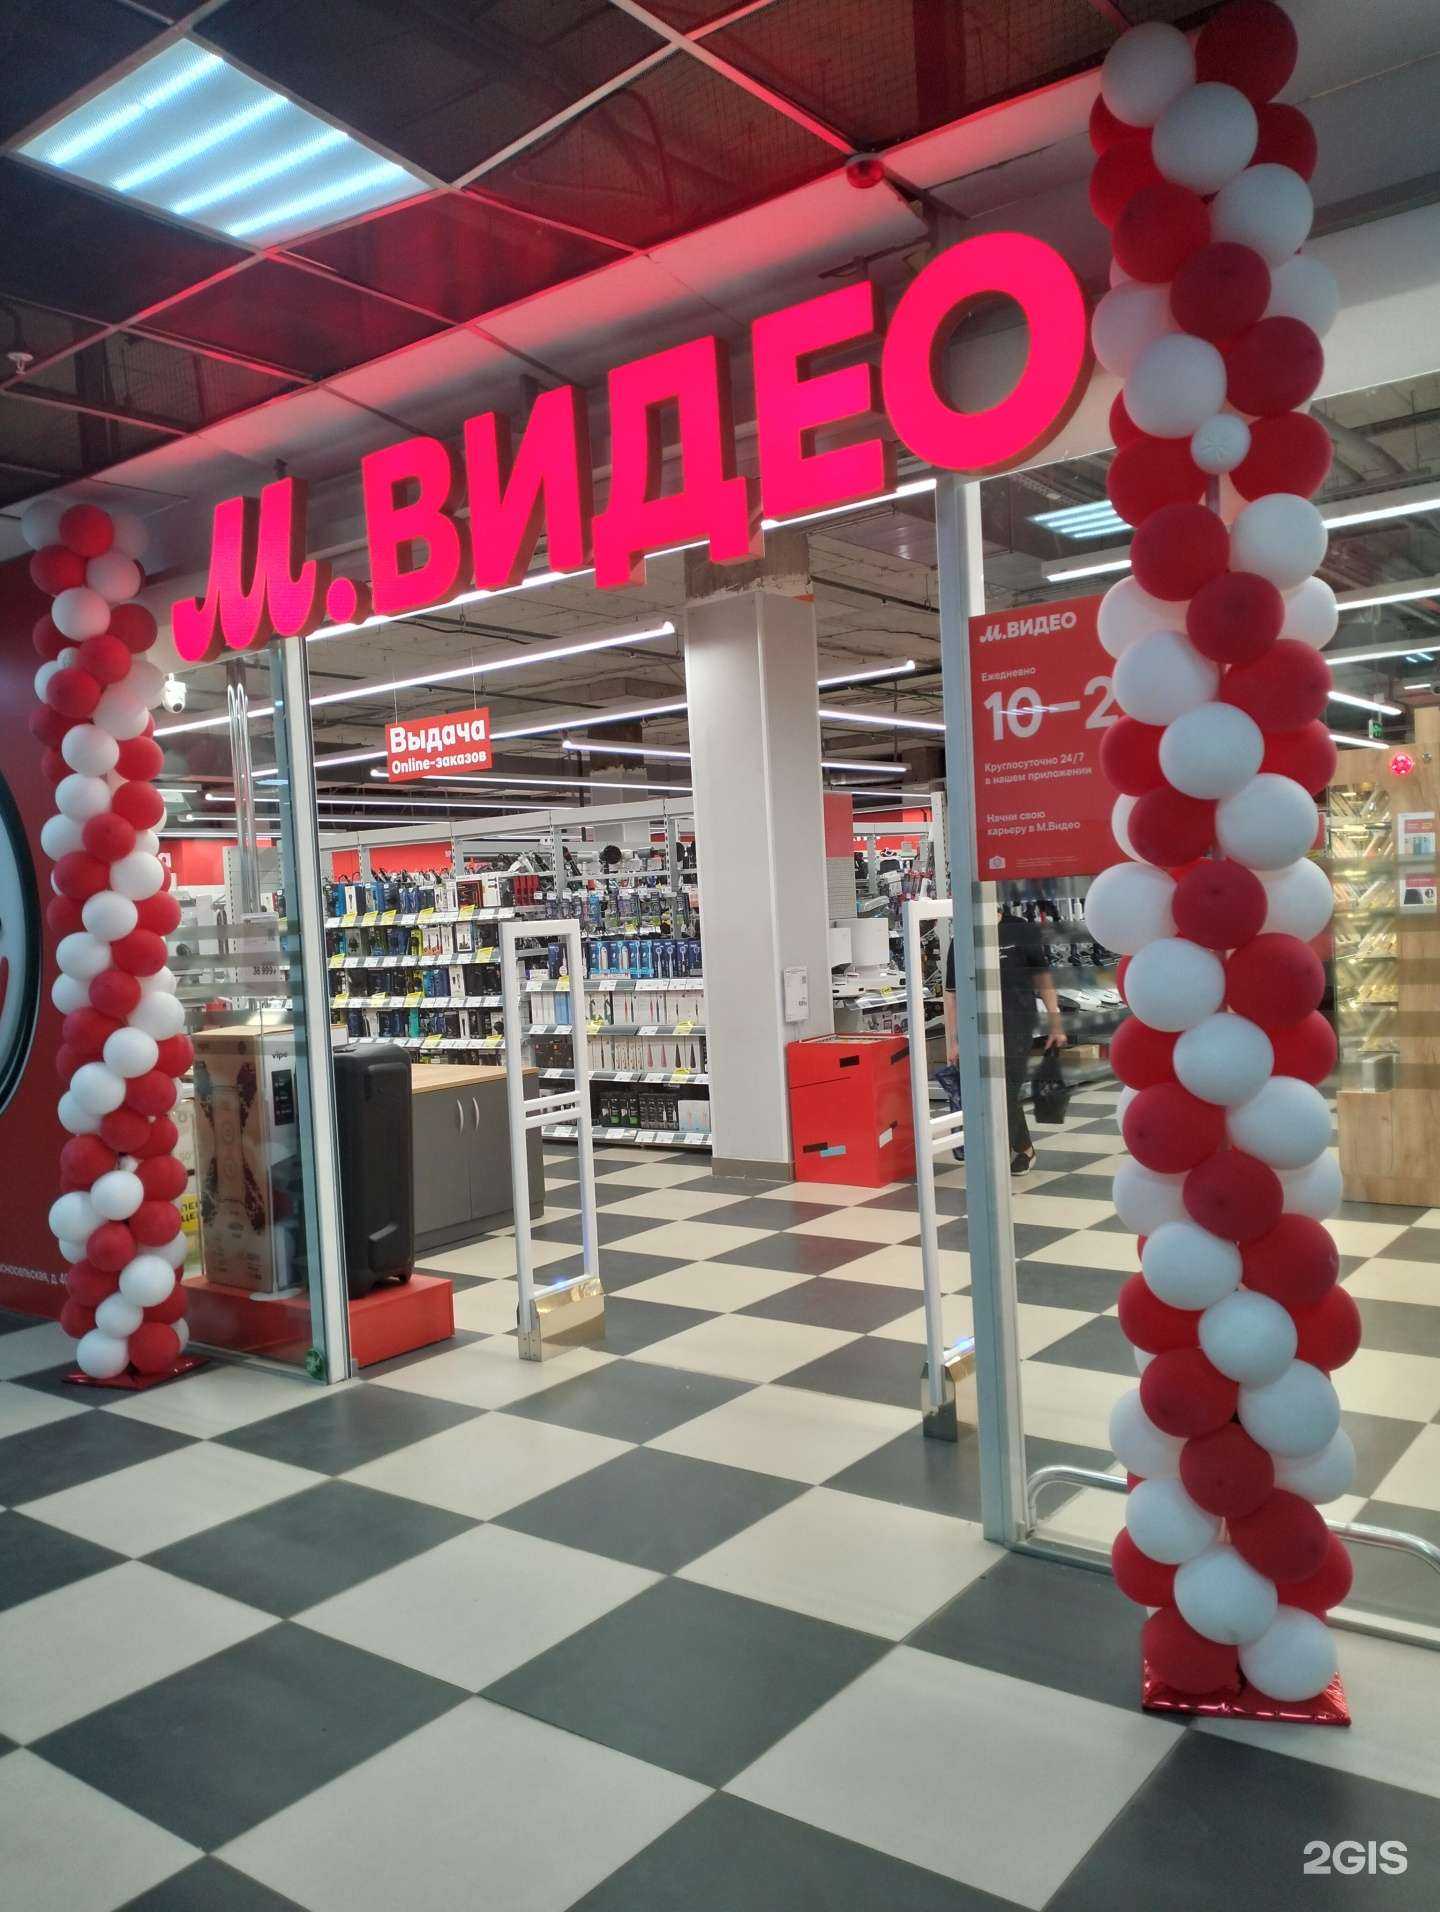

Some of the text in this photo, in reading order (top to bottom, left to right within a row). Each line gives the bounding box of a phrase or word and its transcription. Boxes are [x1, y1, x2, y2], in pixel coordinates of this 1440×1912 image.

[172, 231, 1089, 661] М.ВИДЕО
[979, 611, 1077, 643] М.ВИДЕО
[981, 667, 1037, 682] Ежедневно
[983, 675, 1120, 741] 10–2
[389, 719, 486, 753] Выдача
[391, 751, 487, 774] Online-заказов
[984, 752, 1085, 773] Круглосуточно 24/7
[985, 767, 1092, 785] в нашем приложении
[986, 811, 1046, 823] Начни свою
[987, 821, 1081, 837] карьеру в М.Видео
